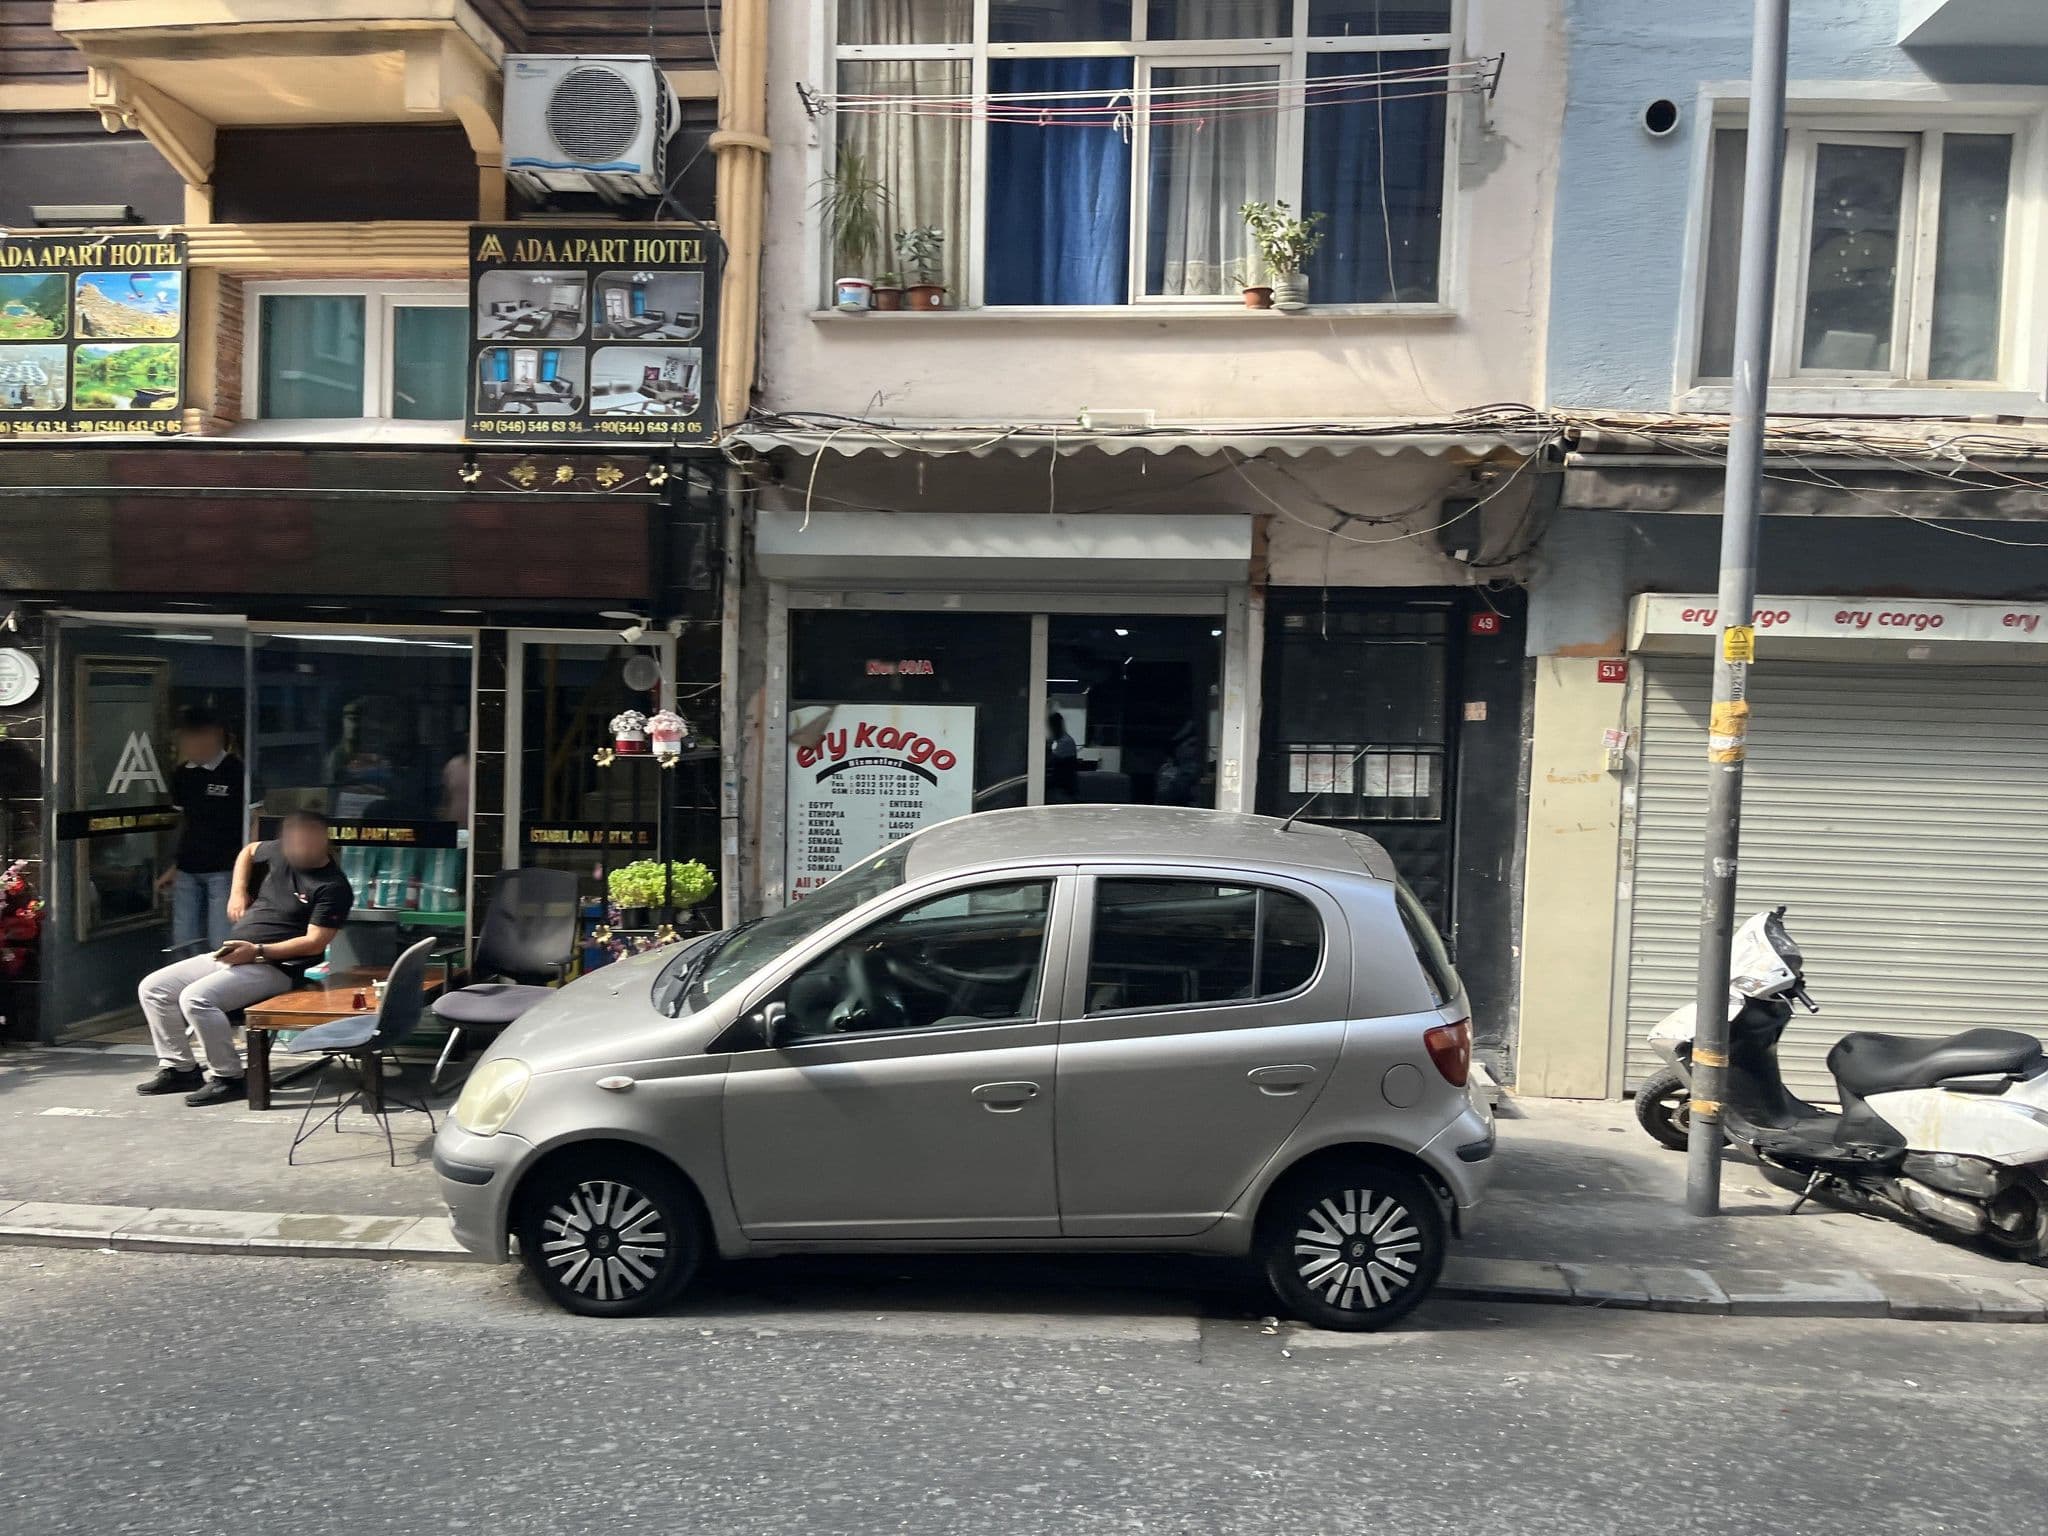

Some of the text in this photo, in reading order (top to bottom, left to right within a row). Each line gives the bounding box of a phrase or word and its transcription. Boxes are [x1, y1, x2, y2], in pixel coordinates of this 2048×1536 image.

[40, 245, 106, 267] APART
[110, 243, 182, 266] HOTEL
[512, 239, 707, 263] ADA APART HOTEL
[471, 421, 583, 434] +90 (546) 546 63 34
[671, 421, 685, 434] 43
[688, 421, 702, 434] 05
[1478, 618, 1493, 629] 49
[1682, 608, 1717, 627] ery
[1835, 609, 1944, 632] ery cargo
[2003, 613, 2040, 634] ery
[796, 721, 957, 771] ery kargo
[808, 801, 834, 809] EGYPT
[808, 810, 845, 818] ETHIOPIA
[888, 821, 914, 829] LAGOS
[808, 828, 840, 836] ANGOLA
[807, 846, 841, 854] ZAMBIA
[807, 864, 843, 872] SOMALIA
